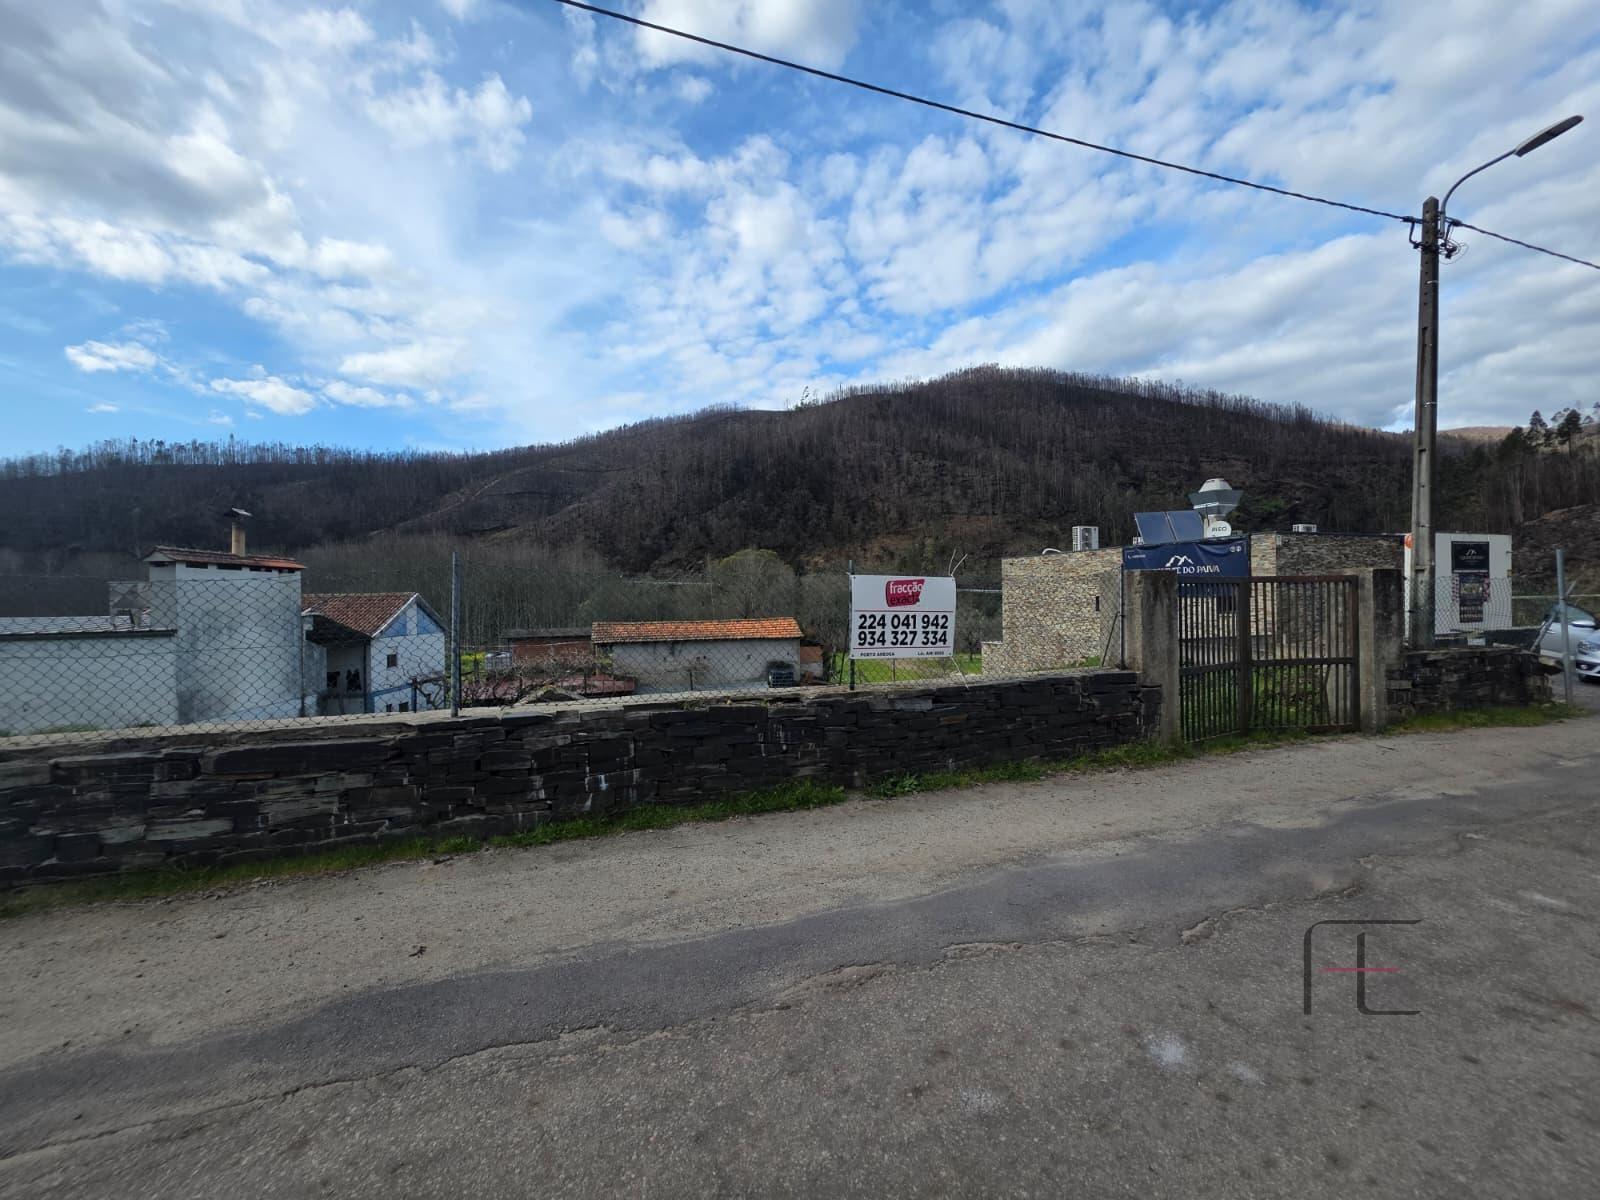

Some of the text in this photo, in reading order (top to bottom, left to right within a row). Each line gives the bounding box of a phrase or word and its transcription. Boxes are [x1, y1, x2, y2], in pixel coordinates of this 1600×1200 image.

[1182, 566, 1195, 574] DO
[1196, 564, 1220, 573] PAIVA
[889, 581, 923, 595] fracção
[858, 614, 949, 630] 224 041 942
[858, 630, 948, 646] 934 327 334
